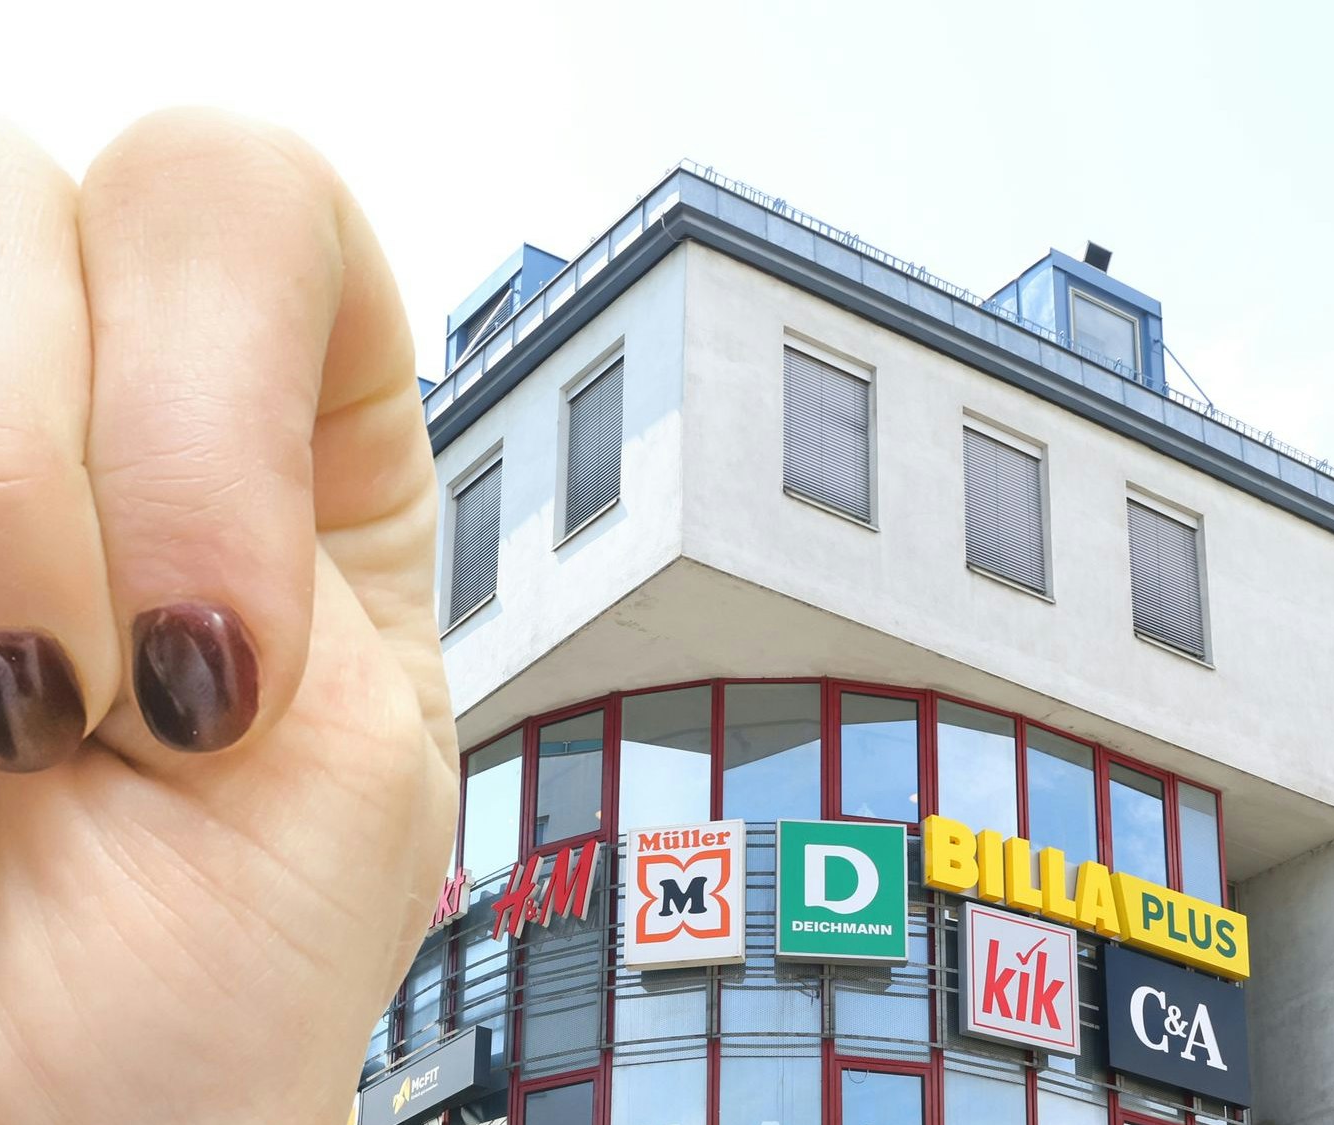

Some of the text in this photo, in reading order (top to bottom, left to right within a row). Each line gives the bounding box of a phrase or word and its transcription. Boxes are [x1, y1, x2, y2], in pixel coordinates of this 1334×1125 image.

[636, 829, 731, 852] Müller
[491, 838, 600, 942] H&M
[658, 876, 708, 917] M
[804, 844, 879, 915] D
[924, 814, 1237, 959] BILLA PLUS
[791, 920, 893, 936] DEICHMANN
[982, 938, 1065, 1031] kik
[1129, 985, 1229, 1072] C&A
[411, 1066, 440, 1093] McFIT
